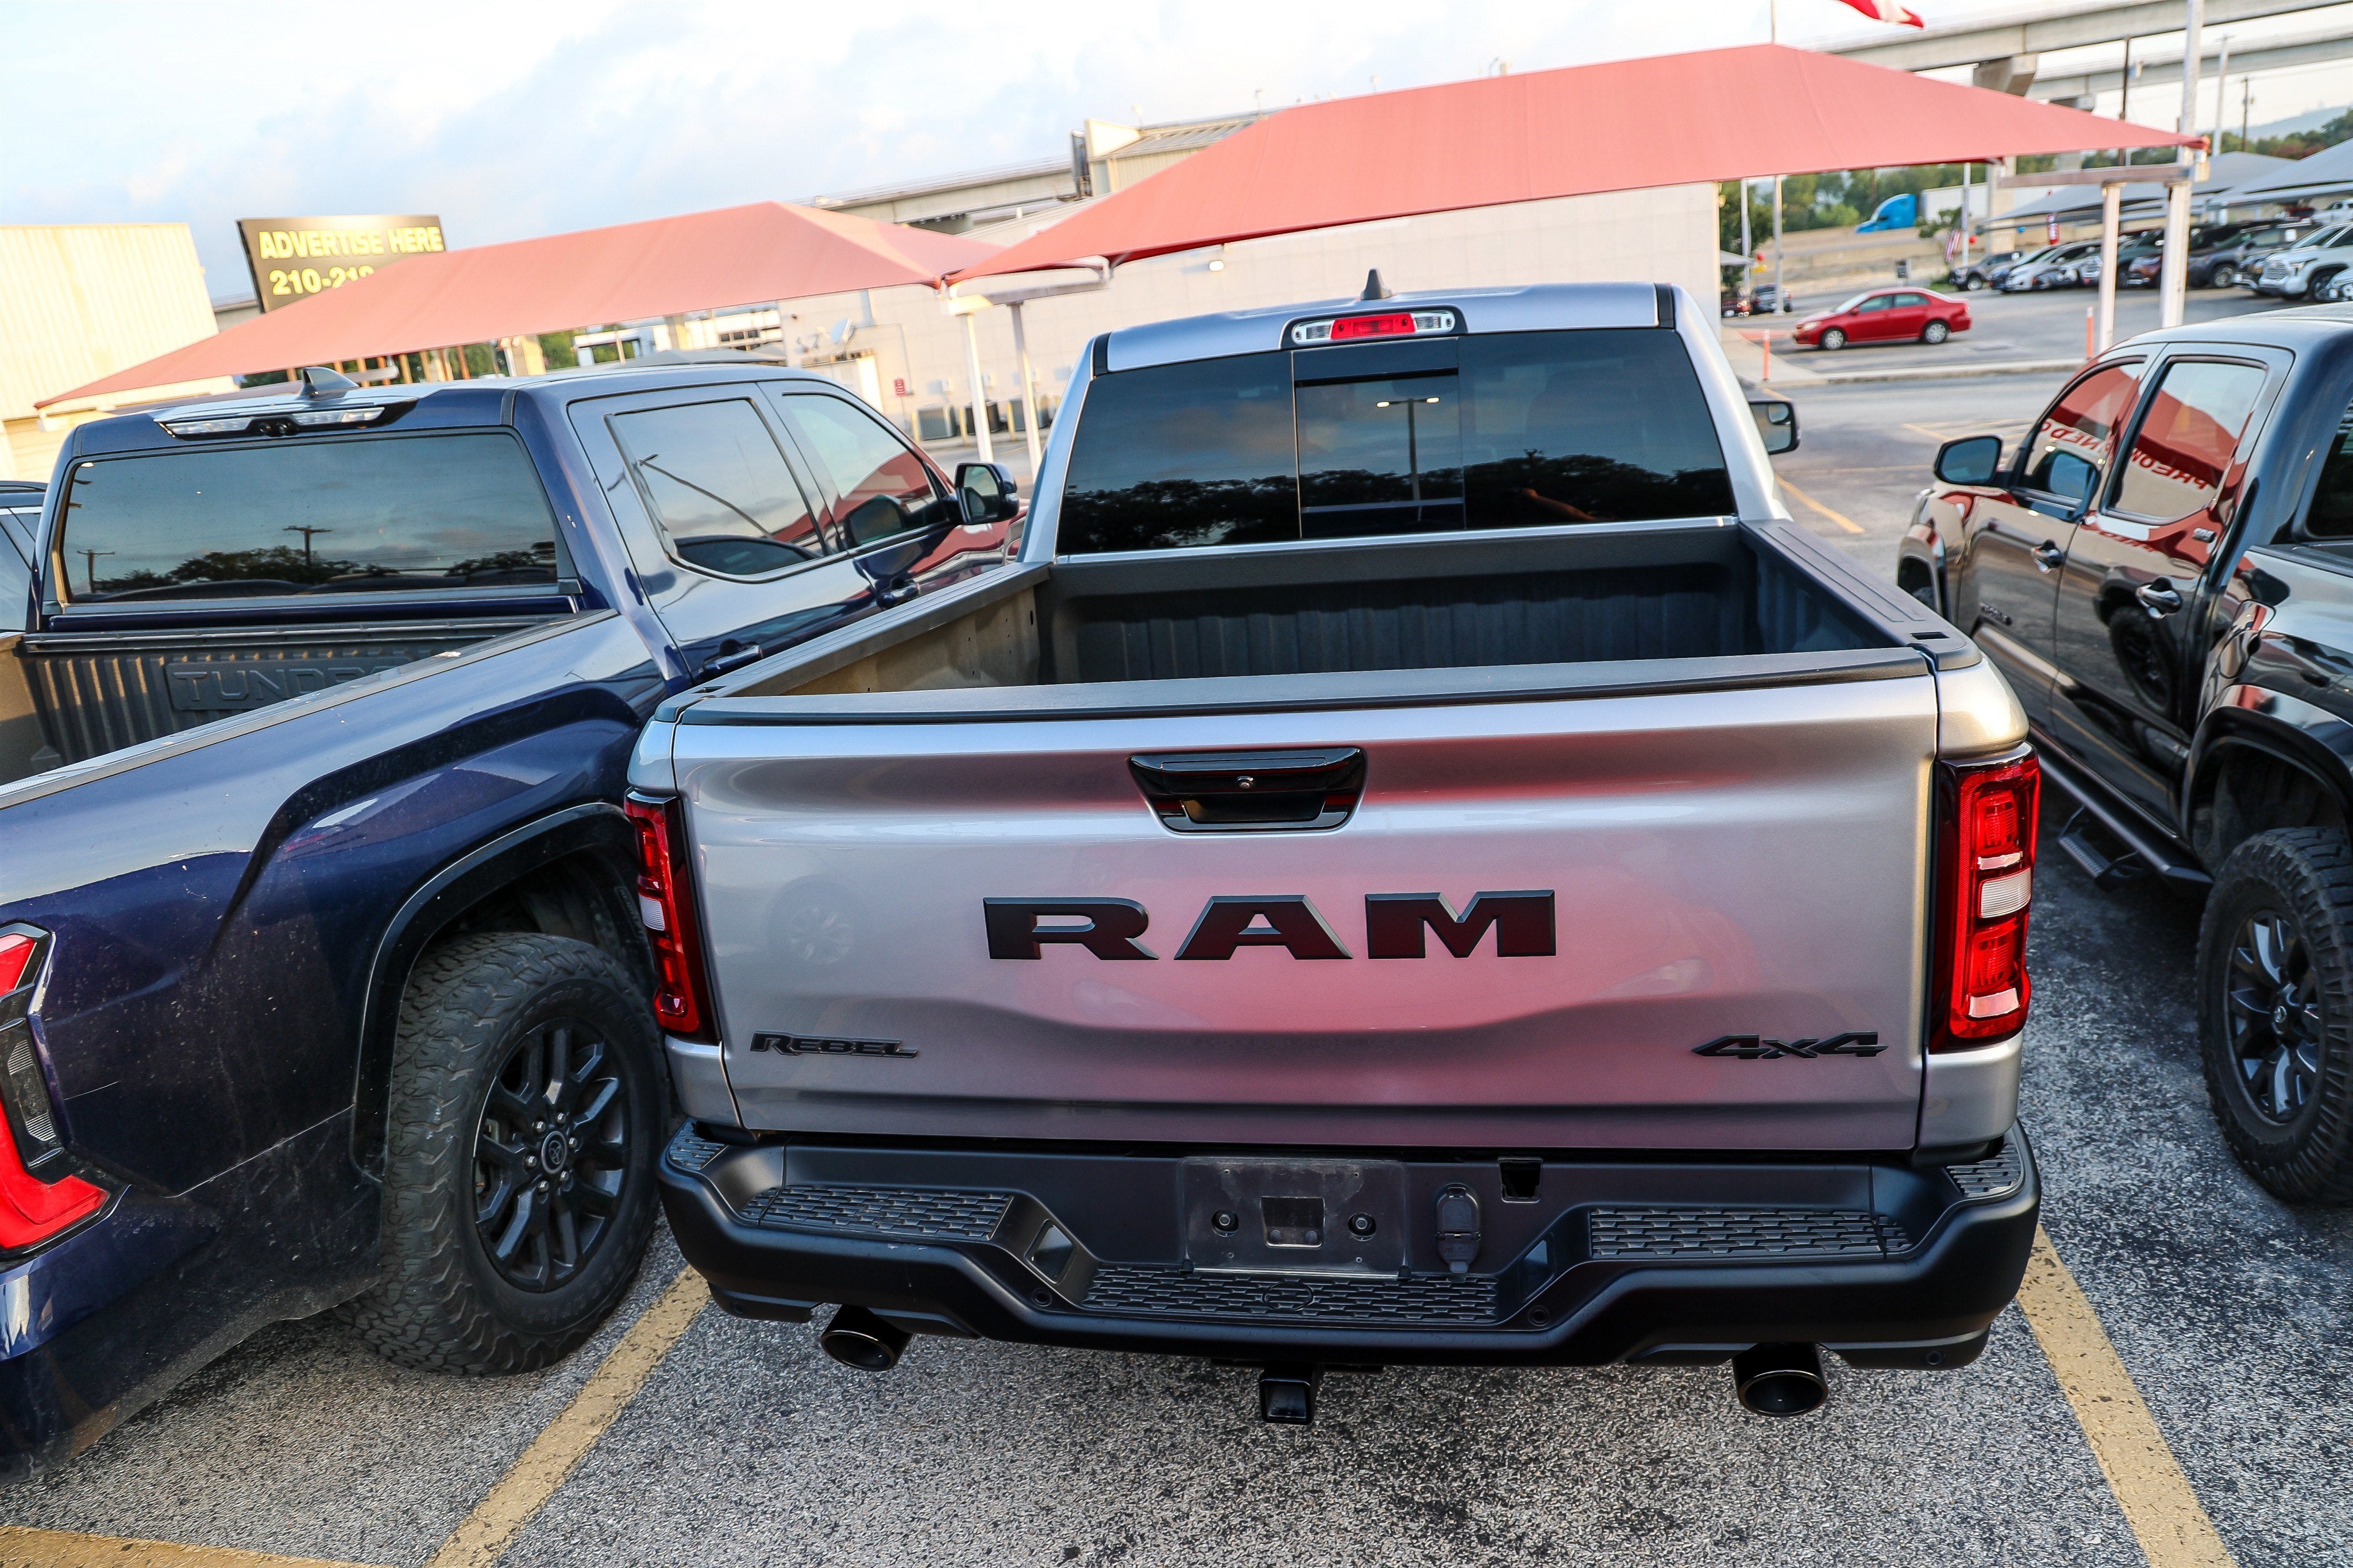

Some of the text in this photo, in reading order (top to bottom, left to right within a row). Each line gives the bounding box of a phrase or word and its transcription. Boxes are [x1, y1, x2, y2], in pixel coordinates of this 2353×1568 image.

[258, 226, 445, 260] ADVERTISE HERE
[982, 890, 1556, 960] RAM
[750, 1030, 919, 1059] REBEL
